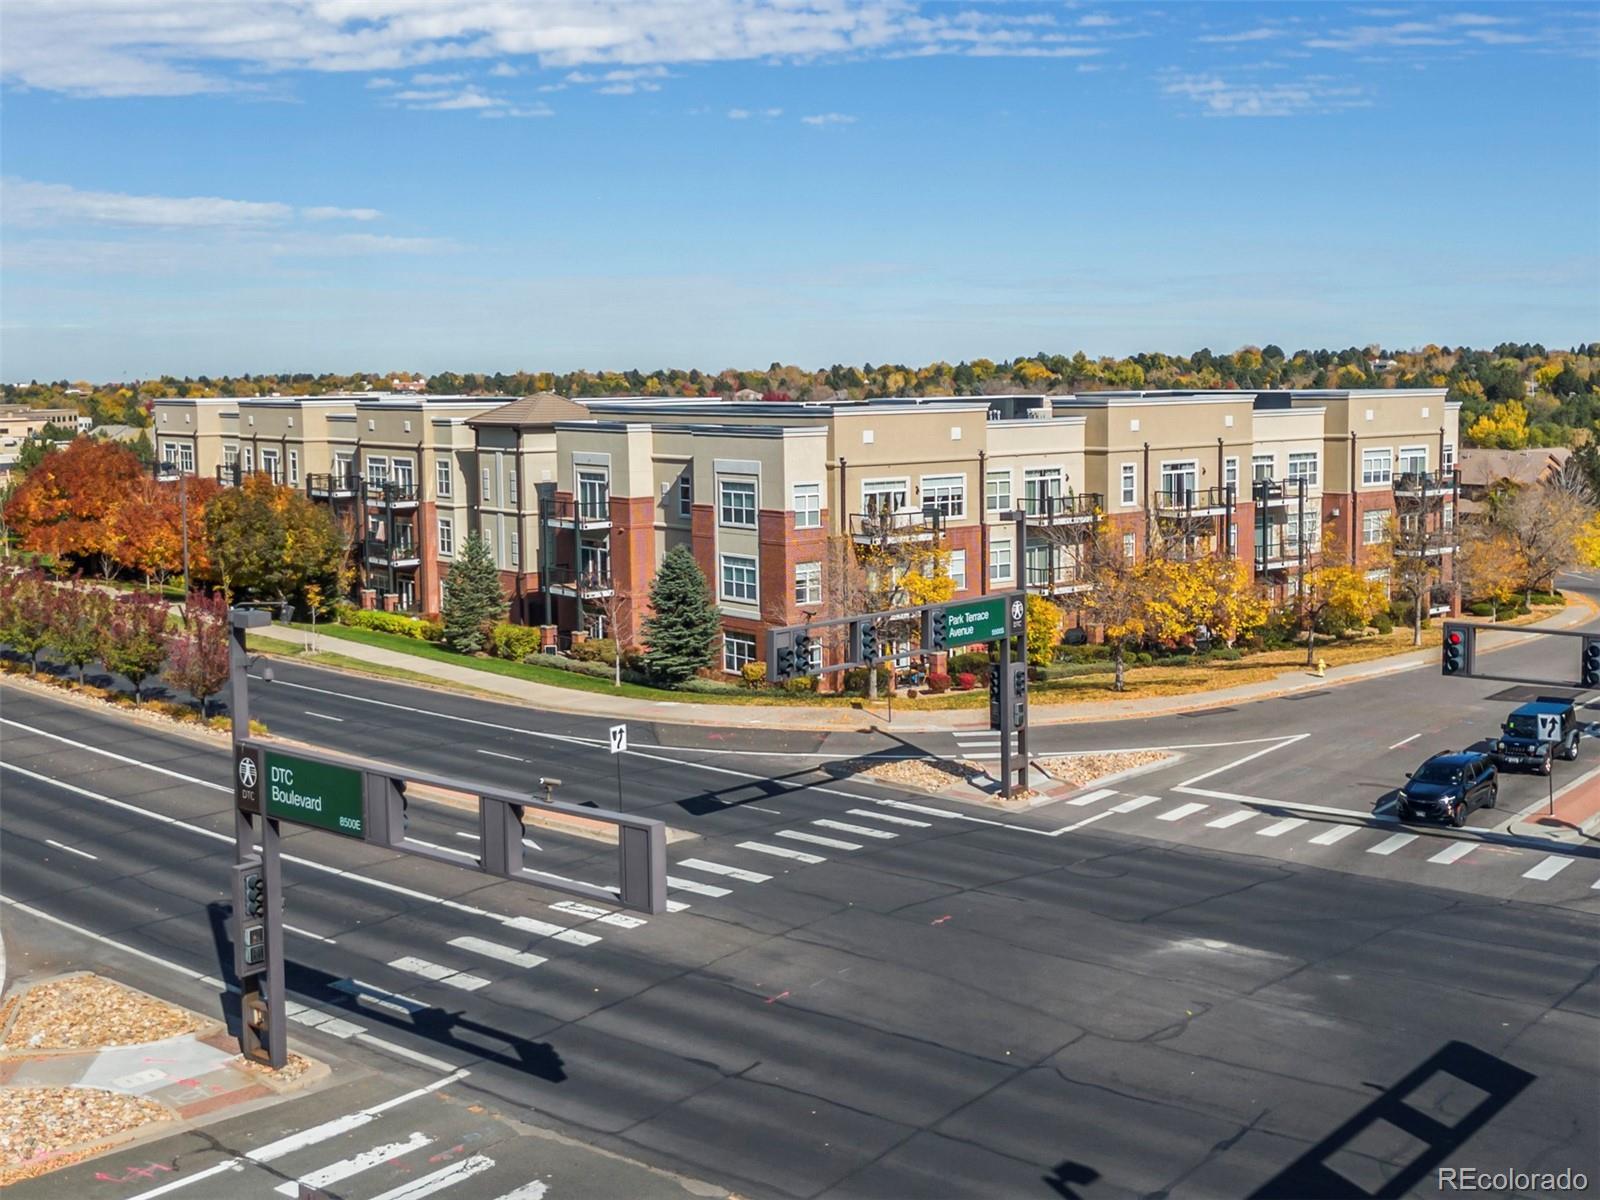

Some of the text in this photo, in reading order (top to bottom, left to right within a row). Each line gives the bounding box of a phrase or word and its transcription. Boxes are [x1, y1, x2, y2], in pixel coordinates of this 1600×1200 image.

[948, 611, 989, 626] Park Terrace
[949, 626, 974, 638] Avenue
[271, 766, 294, 786] DTC
[242, 789, 255, 801] DTC
[272, 785, 322, 812] Boulevard
[339, 816, 361, 831] 8500E
